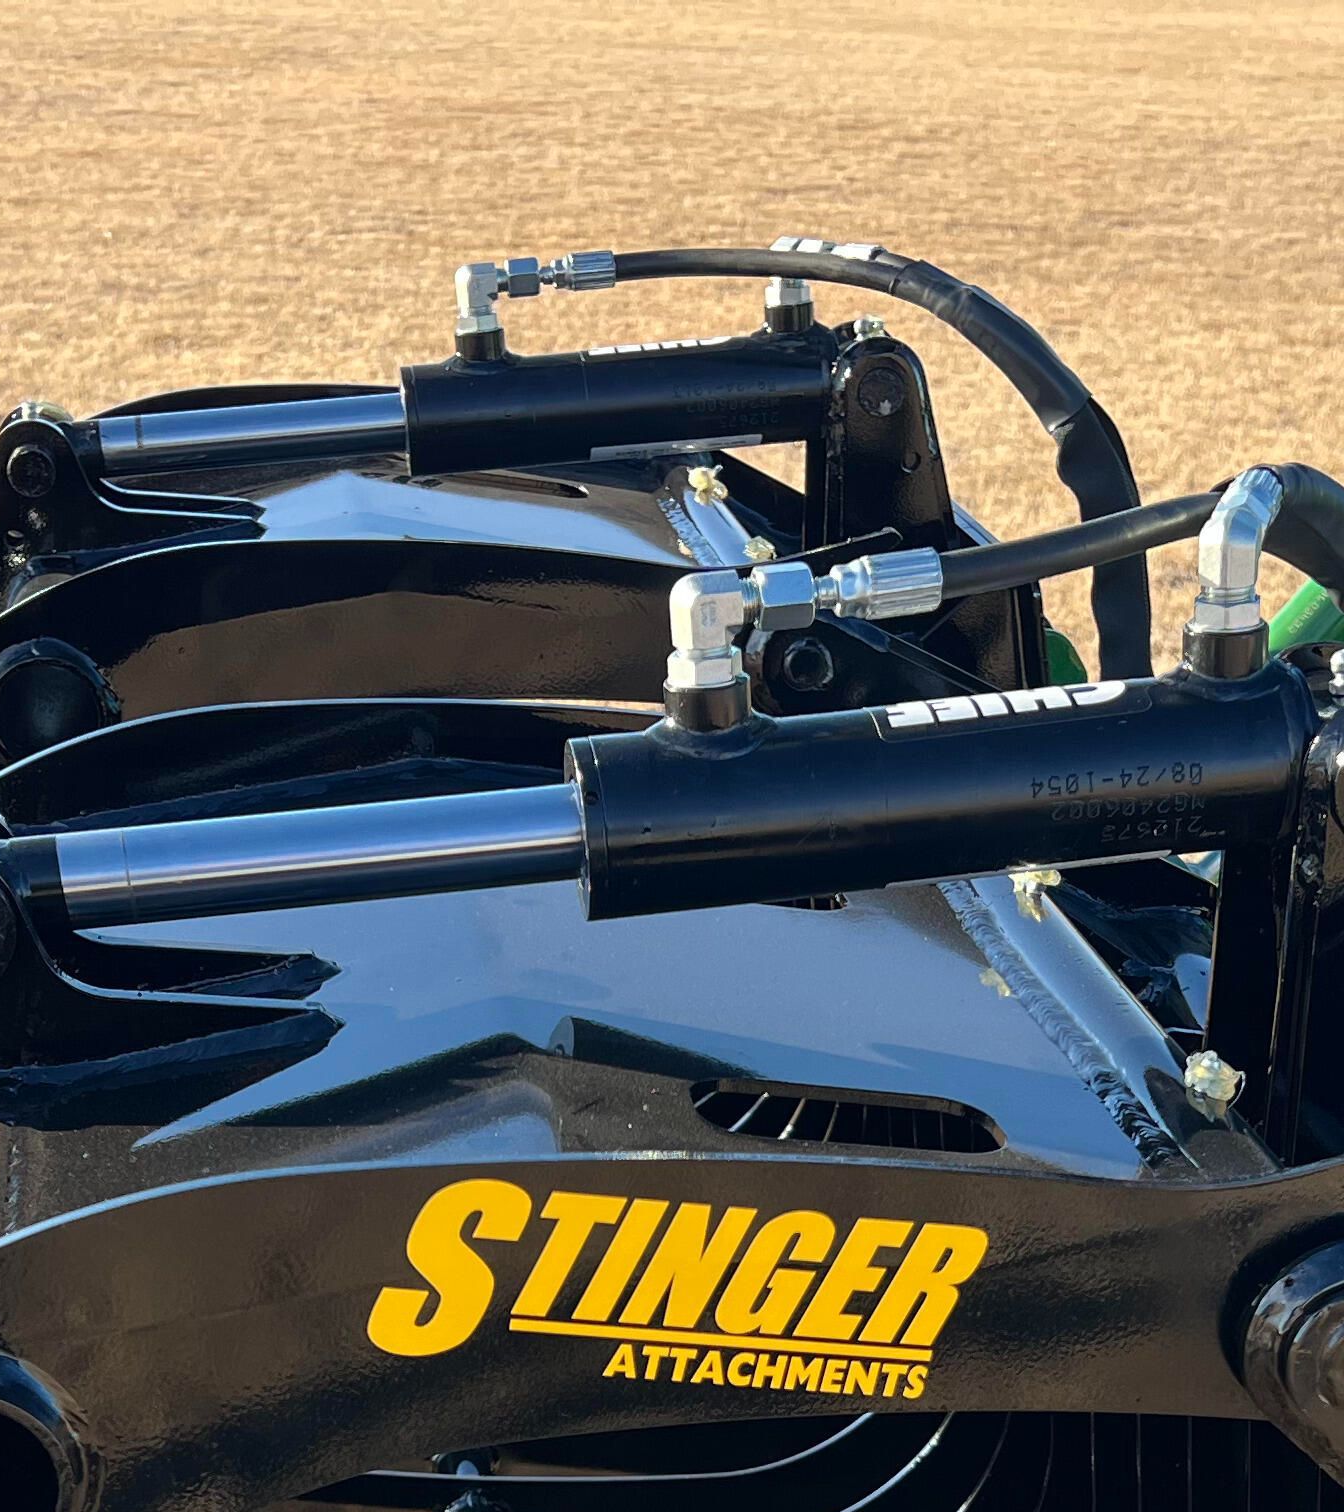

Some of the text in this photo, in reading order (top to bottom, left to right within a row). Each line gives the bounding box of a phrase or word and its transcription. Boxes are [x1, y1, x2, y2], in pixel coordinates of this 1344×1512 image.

[886, 680, 1125, 727] CHIEF
[1030, 762, 1203, 799] 08/24-1054
[1050, 791, 1207, 821] MG2406002
[366, 1178, 989, 1357] STINGER
[603, 1344, 927, 1399] ATTACHMENTS
